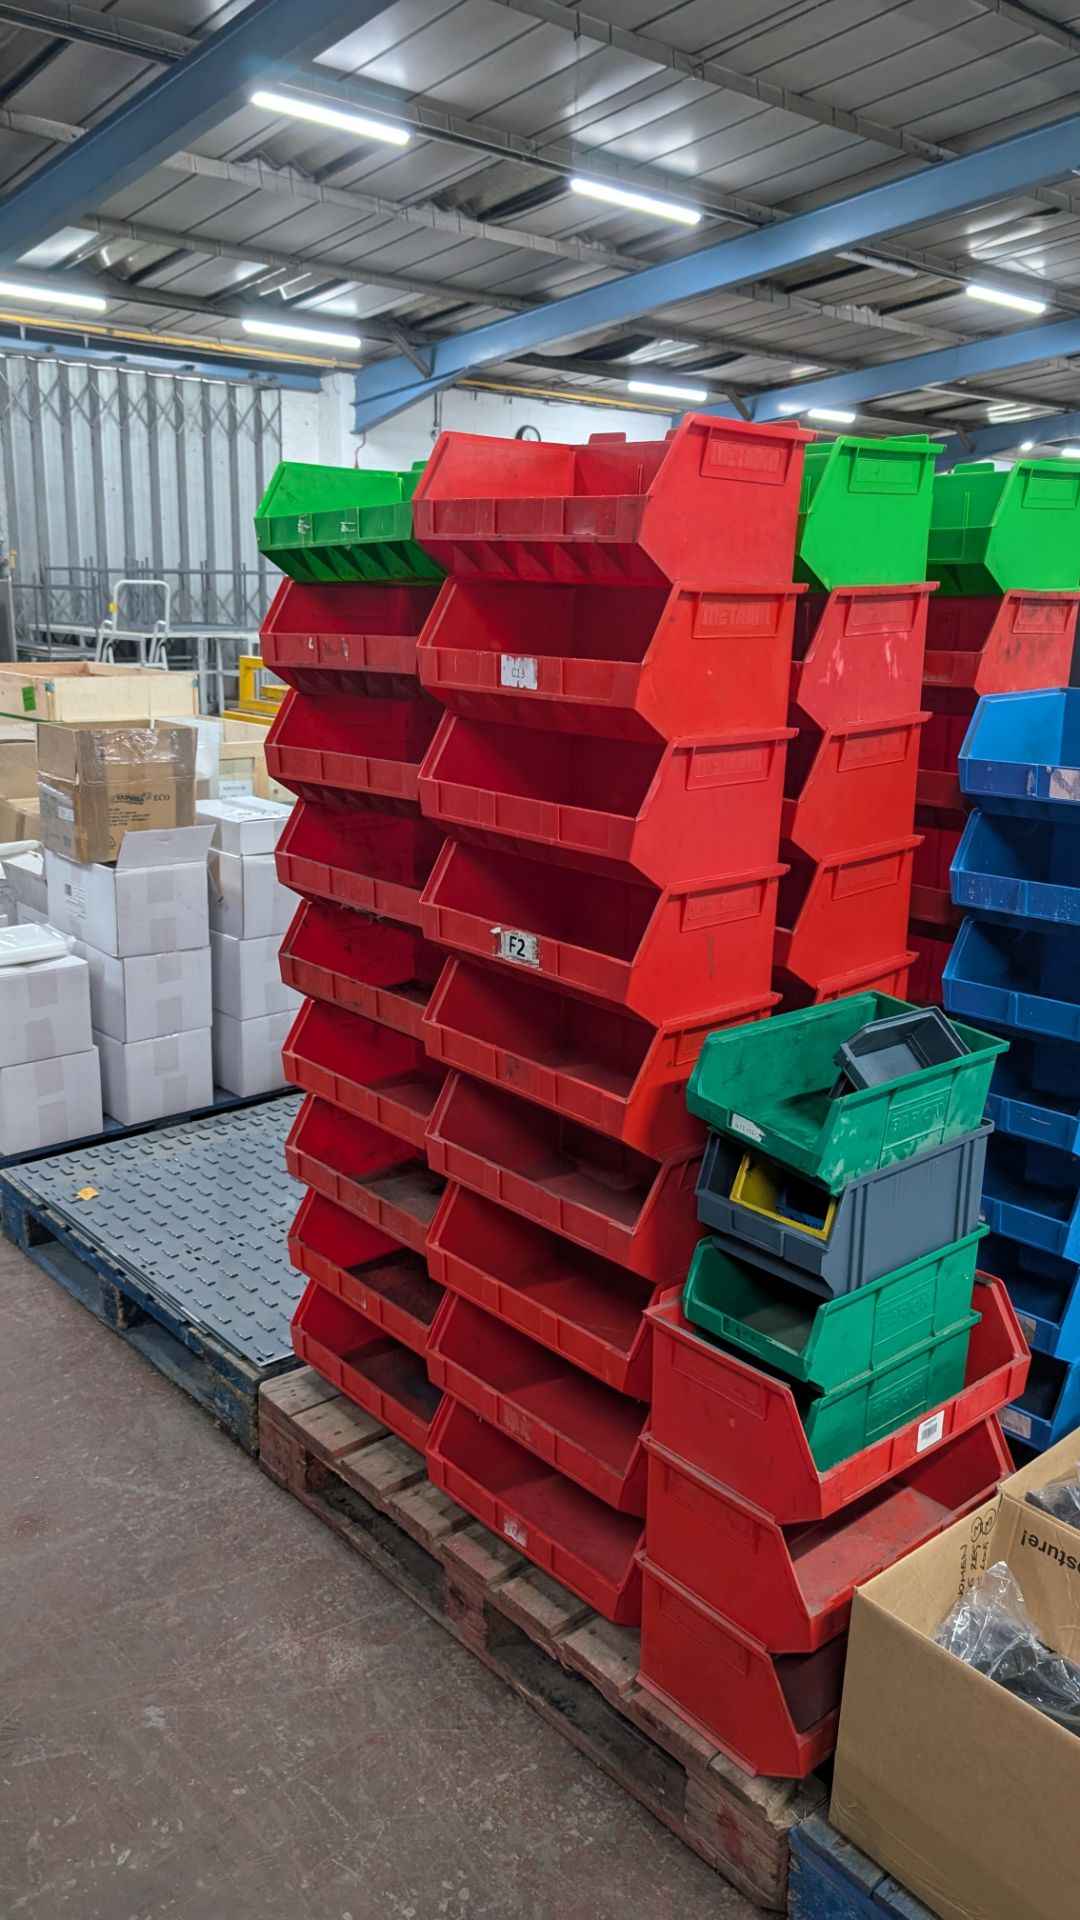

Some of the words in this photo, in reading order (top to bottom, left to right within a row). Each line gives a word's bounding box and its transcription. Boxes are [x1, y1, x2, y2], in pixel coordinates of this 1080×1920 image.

[511, 667, 526, 679] C13
[153, 793, 170, 802] ECO
[508, 935, 526, 958] F2
